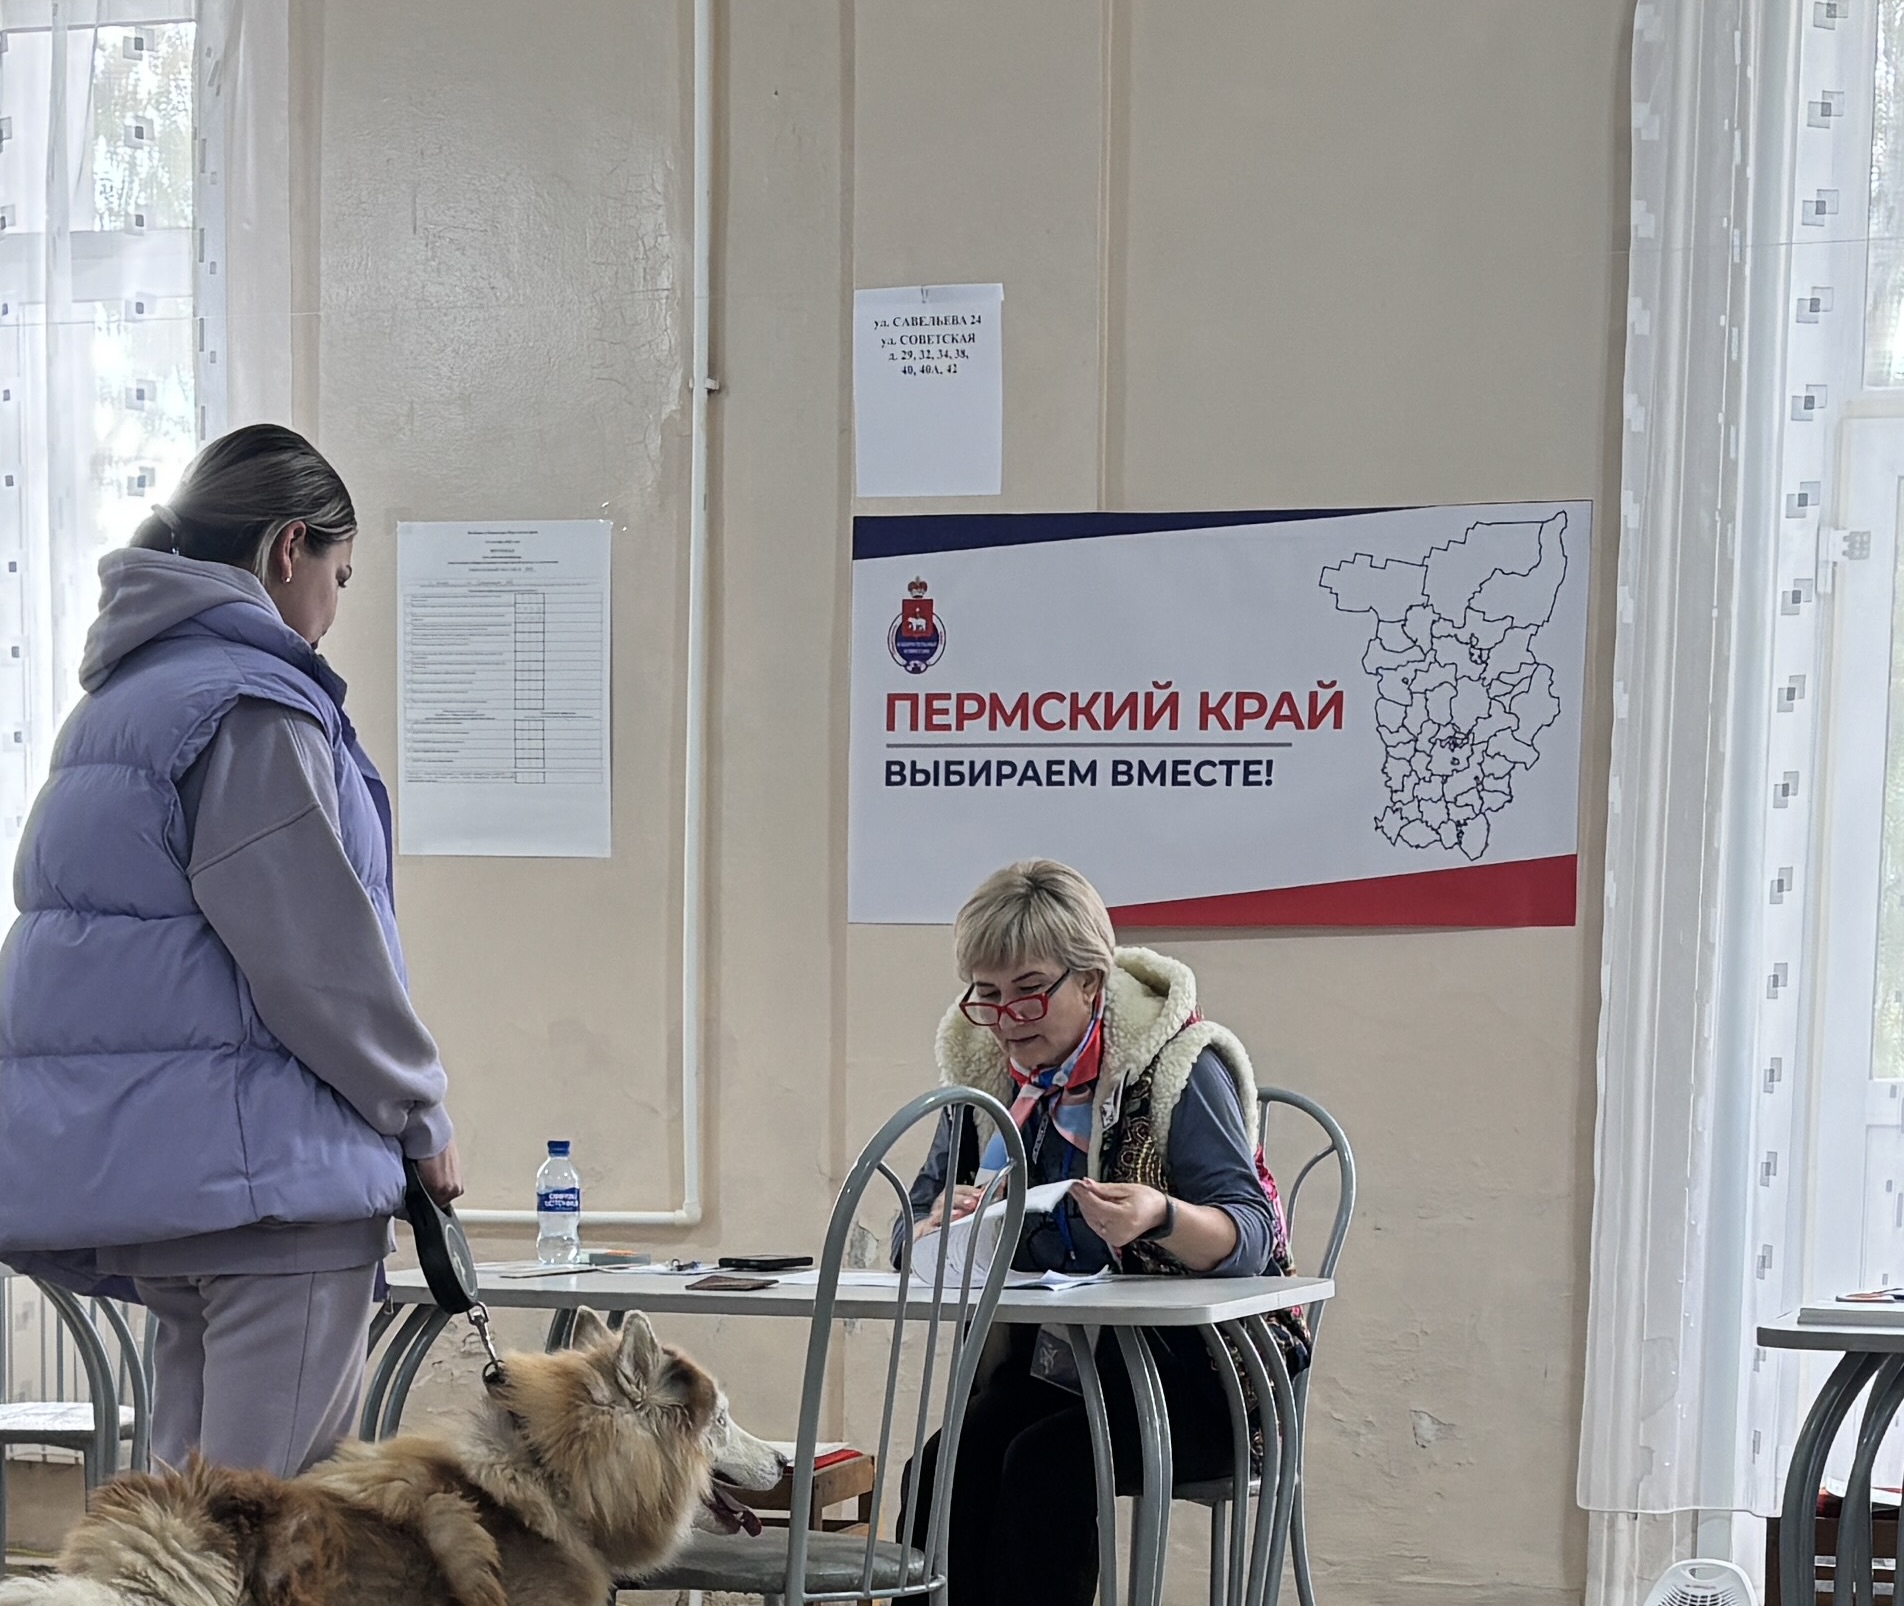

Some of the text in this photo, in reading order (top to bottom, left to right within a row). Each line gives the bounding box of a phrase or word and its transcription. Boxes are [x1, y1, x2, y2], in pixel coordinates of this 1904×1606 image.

[892, 315, 967, 327] САВЕЛЬЕВА
[970, 314, 982, 325] 24
[900, 333, 976, 345] СОВЕТСКАЯ
[885, 680, 1344, 733] ПЕРМСКИЙ КРАЙ
[885, 758, 1274, 788] ВЫБИРАЕМ ВМЕСТЕ!
